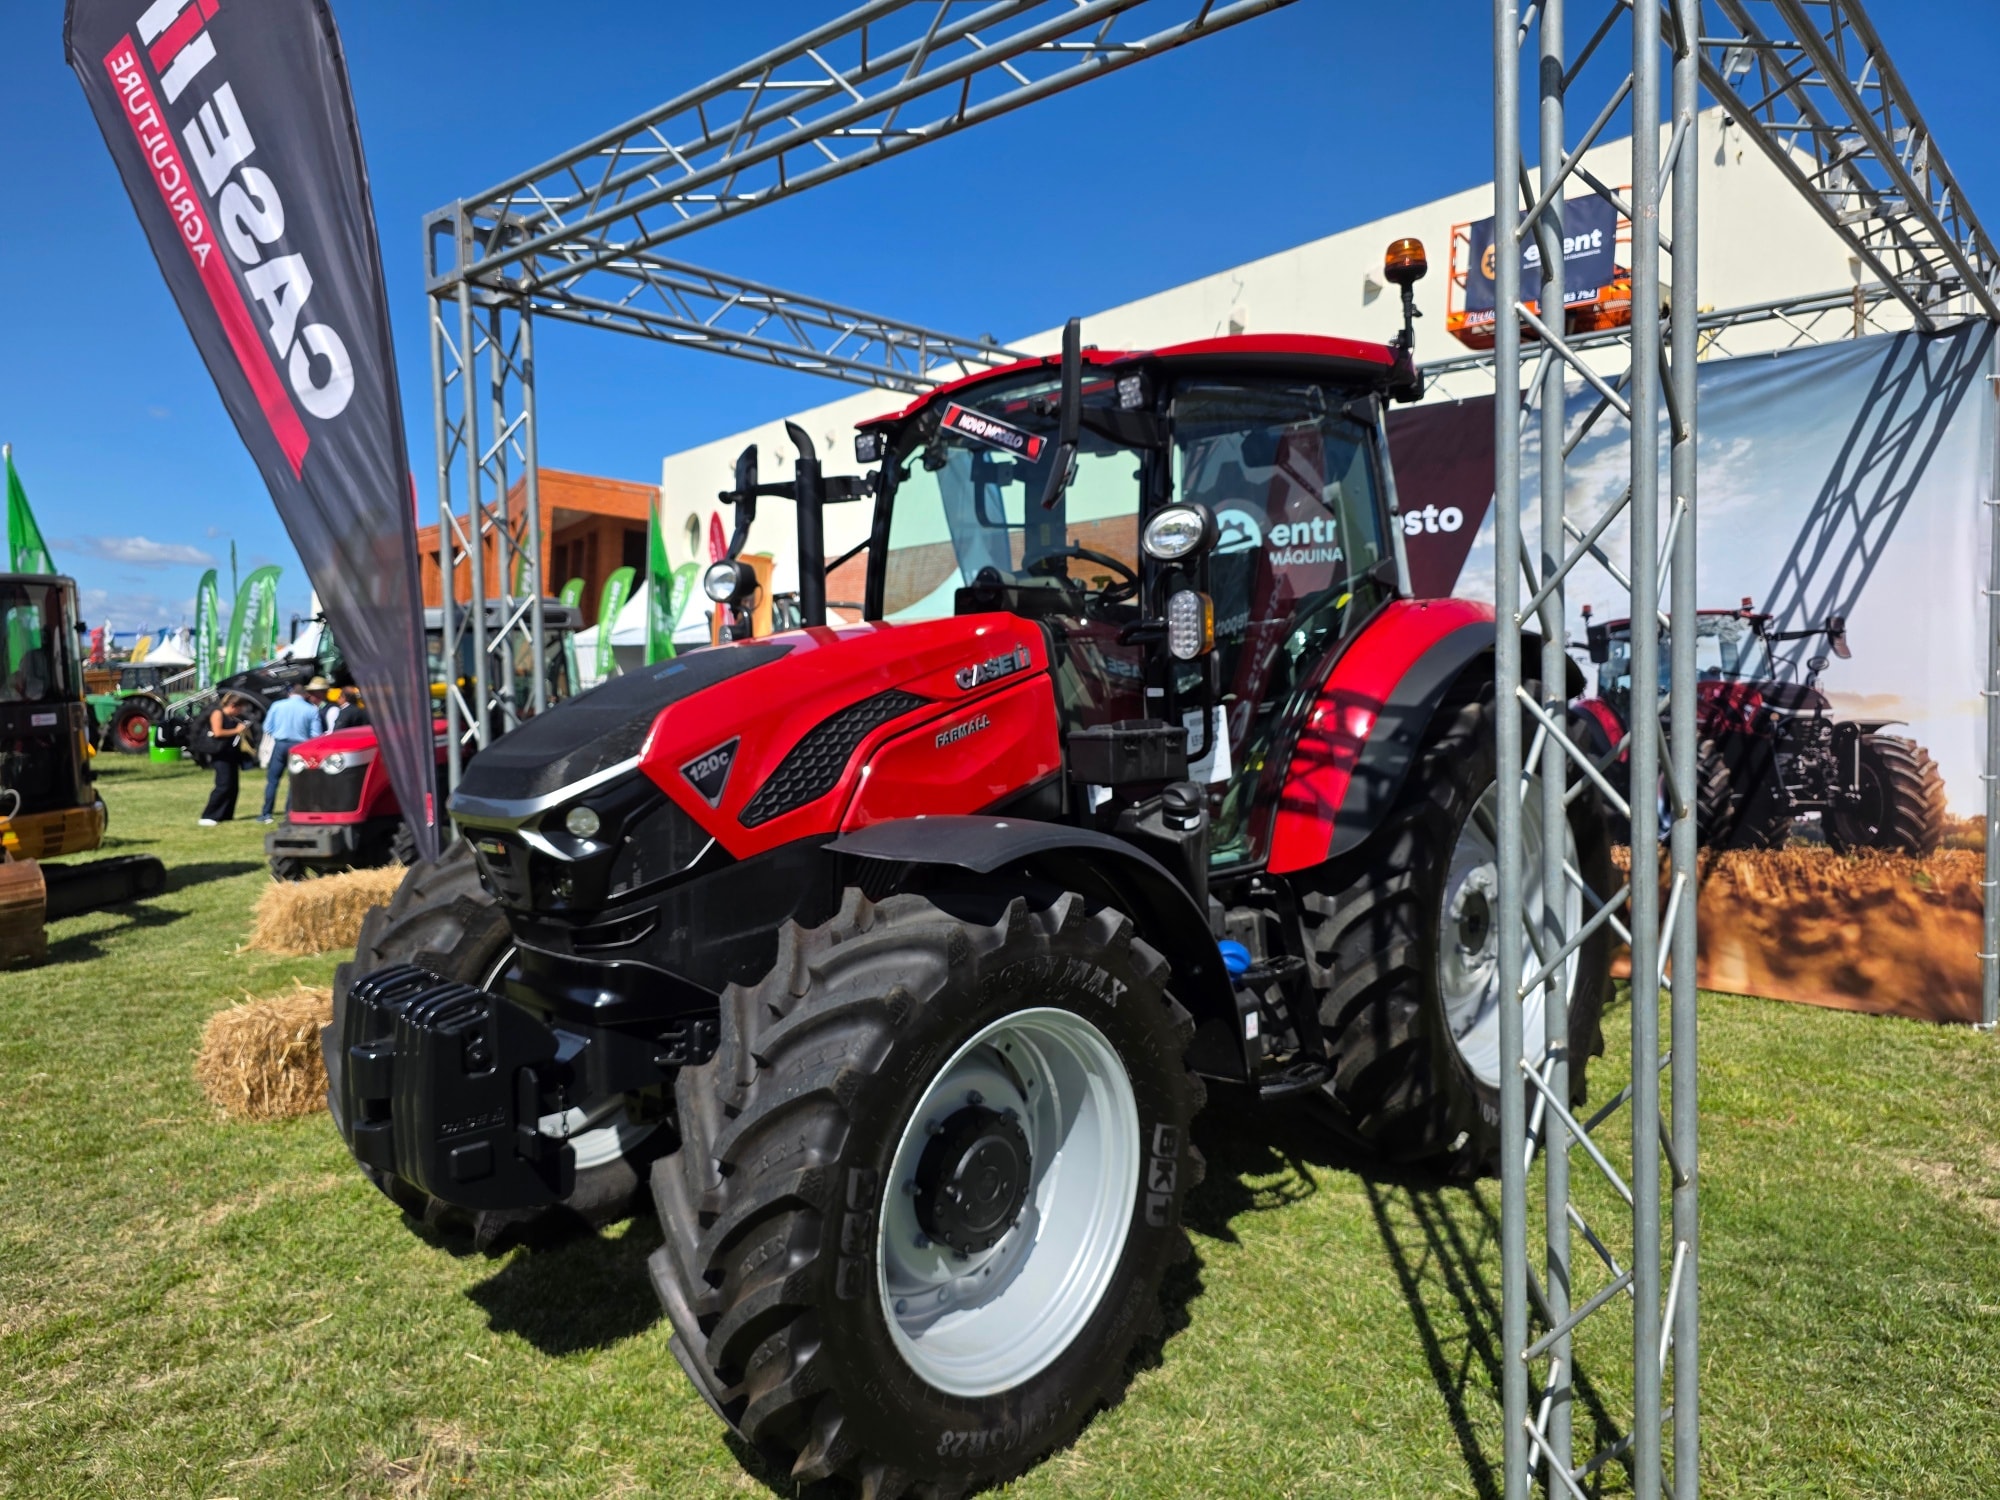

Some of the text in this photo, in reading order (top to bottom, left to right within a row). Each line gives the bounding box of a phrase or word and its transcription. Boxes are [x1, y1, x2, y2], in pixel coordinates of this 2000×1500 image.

[958, 414, 1024, 449] NOVO MODELO
[955, 653, 1013, 689] CASE
[935, 714, 990, 749] FARMALL
